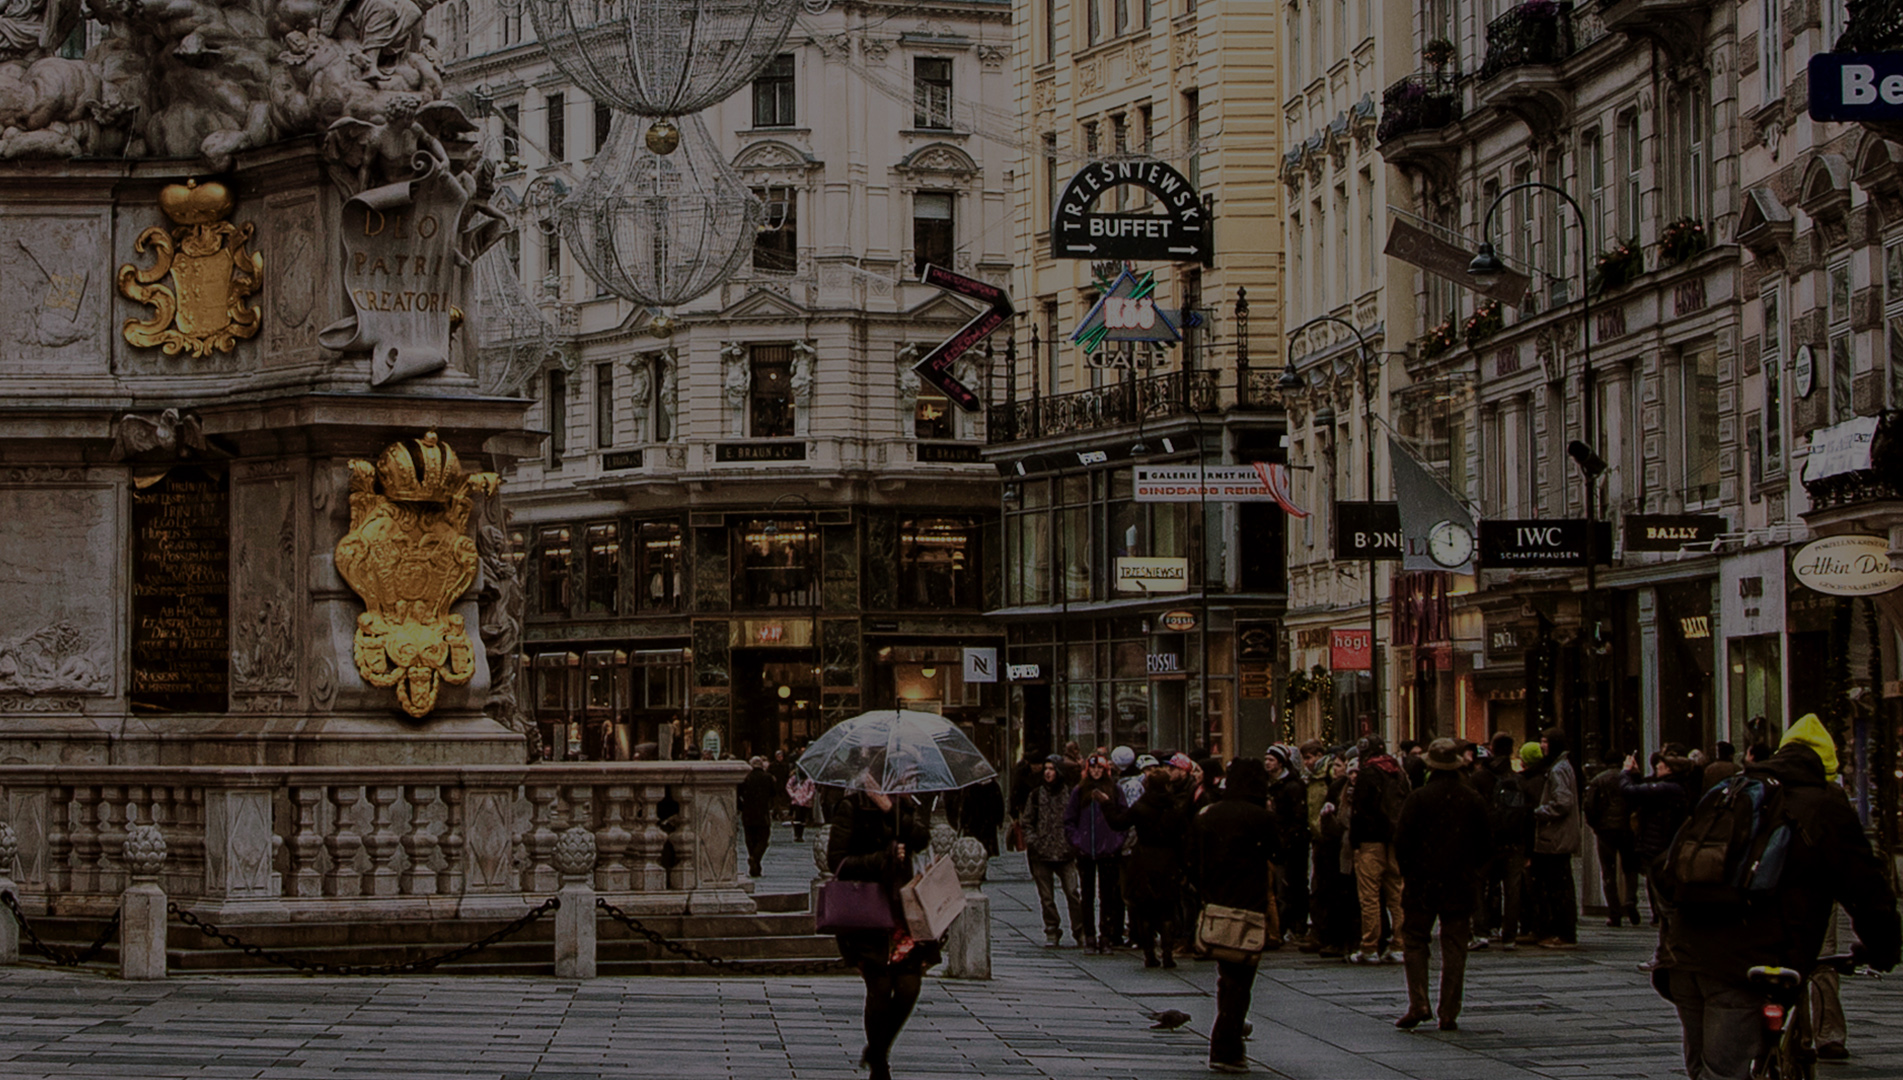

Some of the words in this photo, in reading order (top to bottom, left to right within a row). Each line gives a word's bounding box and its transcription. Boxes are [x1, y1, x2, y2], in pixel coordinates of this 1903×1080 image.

[364, 210, 437, 239] DEO
[1090, 218, 1172, 238] BUFFET
[354, 252, 442, 276] PATRI
[353, 290, 448, 312] CREATORI
[738, 446, 772, 458] BRAUN
[1151, 471, 1197, 480] GALERIE
[1202, 471, 1235, 480] RNST
[1238, 471, 1261, 480] HIL
[1224, 486, 1269, 495] REISE
[1354, 529, 1404, 552] BON
[1516, 527, 1562, 547] IWC
[1646, 527, 1698, 539] BALLY
[1500, 551, 1580, 560] SCHAFFHAUSEN
[1799, 556, 1850, 575] Albin
[1166, 616, 1195, 625] FOSSIL
[1335, 634, 1368, 650] högl
[1146, 653, 1178, 671] FOSSIL
